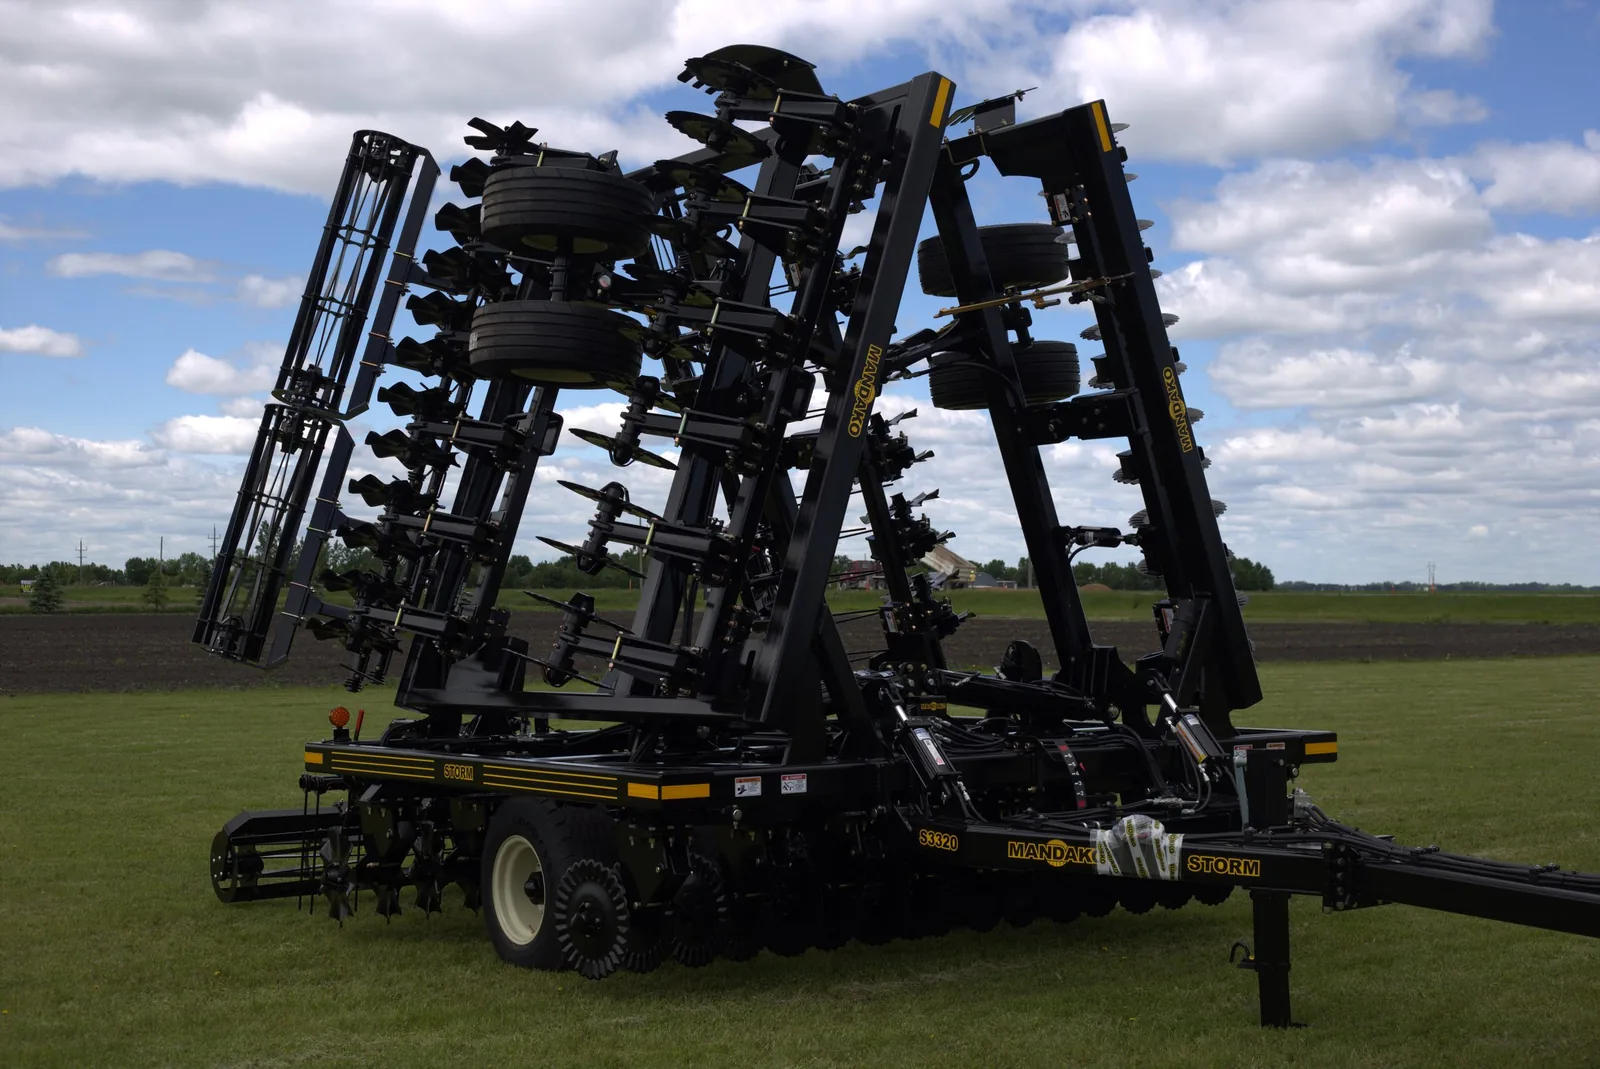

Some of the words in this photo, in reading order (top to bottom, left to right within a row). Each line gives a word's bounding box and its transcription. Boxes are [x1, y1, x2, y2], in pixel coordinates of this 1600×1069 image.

[847, 343, 882, 438] MANDAKO
[1163, 366, 1193, 453] MANDAKO
[444, 763, 474, 781] STORM
[919, 828, 959, 851] S3320
[1187, 854, 1261, 877] STORM
